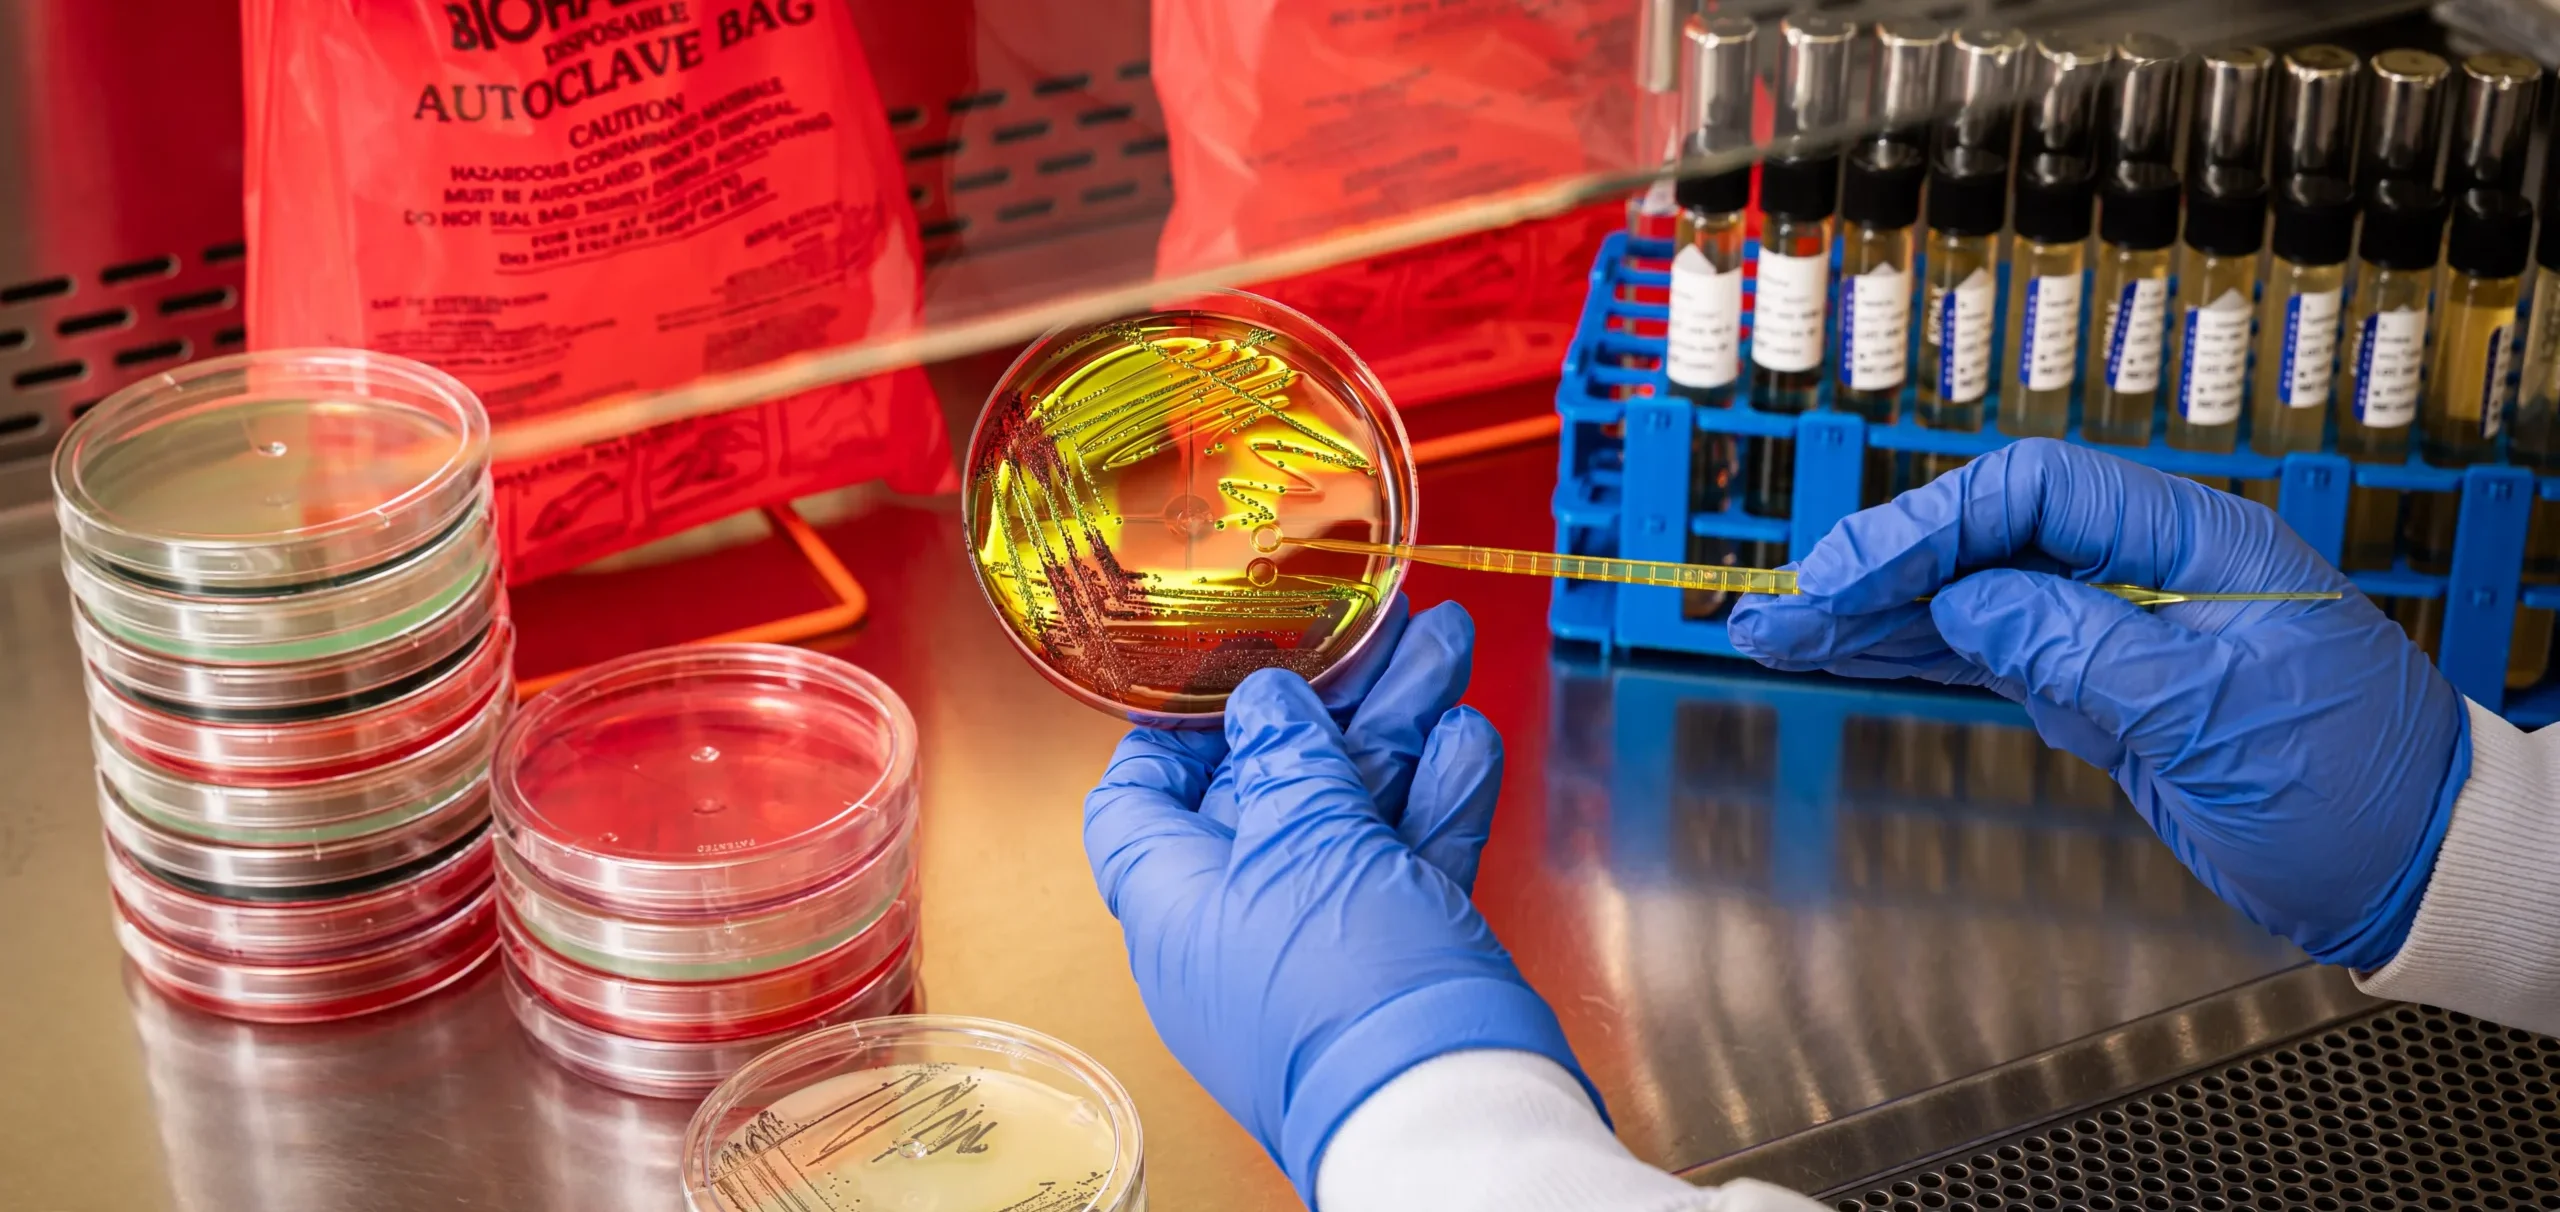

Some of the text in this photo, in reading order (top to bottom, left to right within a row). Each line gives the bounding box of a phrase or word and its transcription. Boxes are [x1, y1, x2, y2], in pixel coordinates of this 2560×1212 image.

[543, 2, 690, 65] DISPOSABLE
[413, 0, 814, 122] AUTOCLAVE BAG
[568, 92, 685, 148] CAUTION
[444, 188, 494, 204] MUST
[502, 189, 521, 203] BE
[530, 161, 645, 204] AUTOCLAVED
[451, 161, 569, 181] HAZARDOUS
[404, 209, 437, 226] DO
[442, 210, 481, 227] NOT
[490, 210, 531, 227] SEAL
[538, 203, 578, 224] BAG
[697, 838, 756, 853] PATENTED
